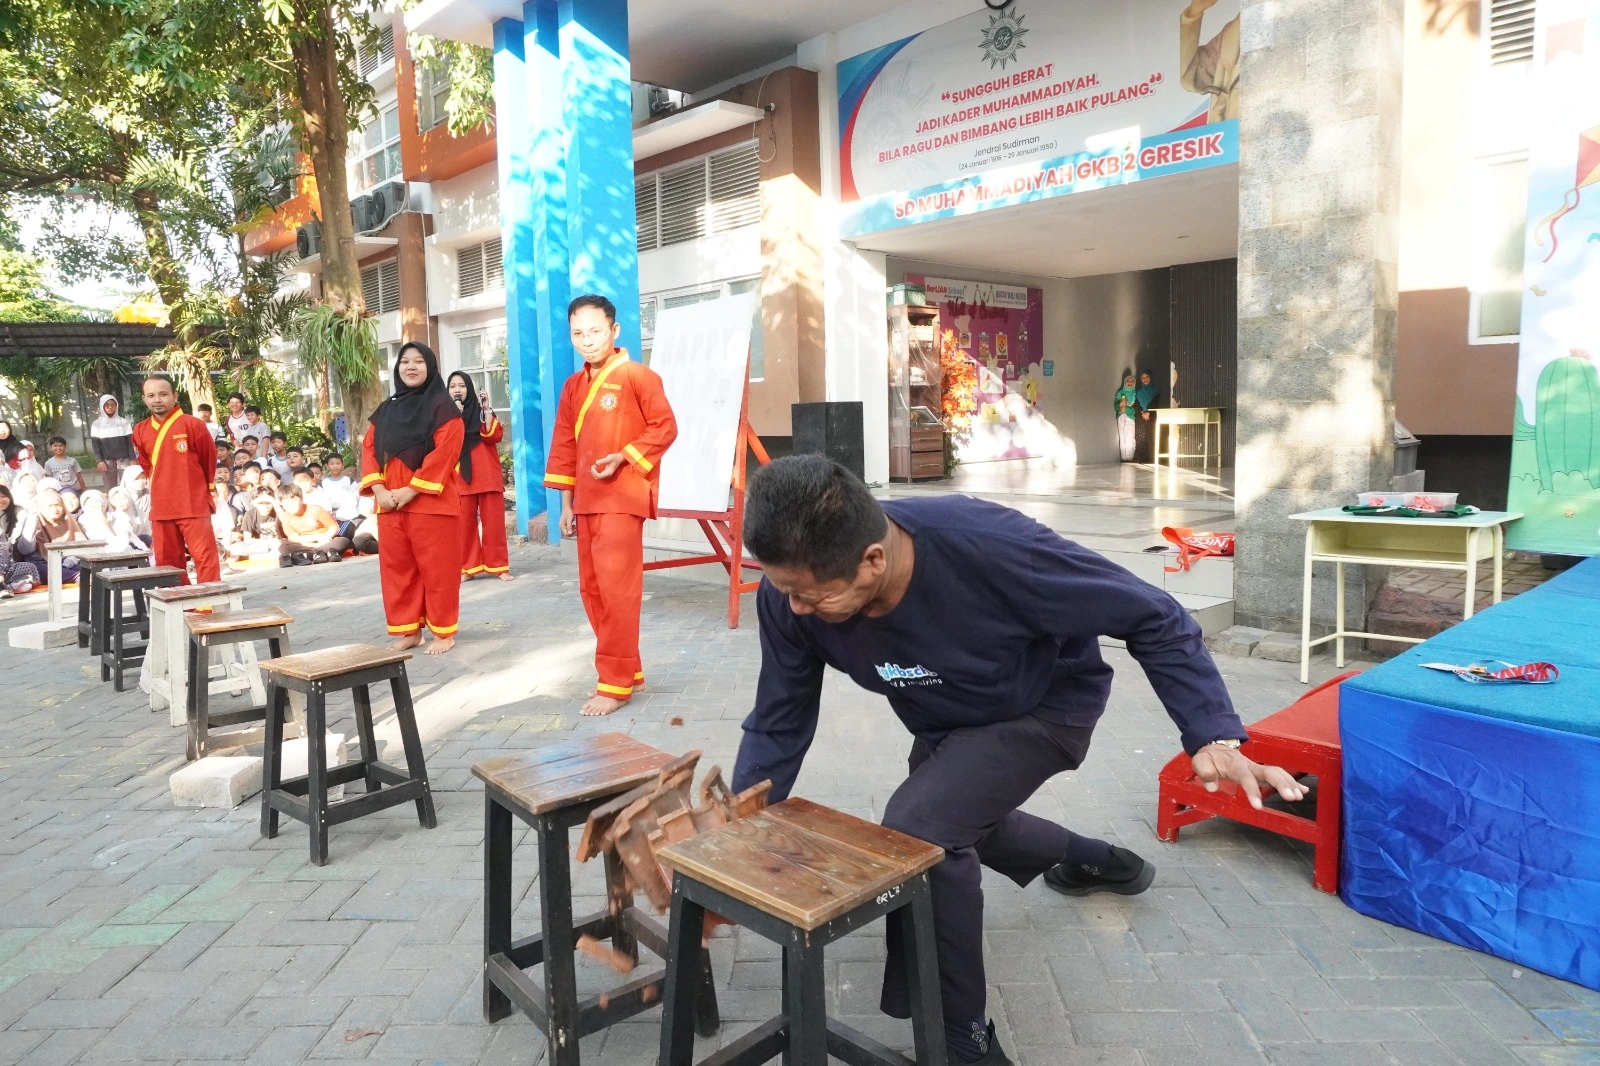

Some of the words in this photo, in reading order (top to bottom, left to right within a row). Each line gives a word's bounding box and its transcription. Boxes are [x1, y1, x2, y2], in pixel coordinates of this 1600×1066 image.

[1012, 64, 1052, 86] BERAT
[916, 117, 940, 133] JADI
[942, 106, 980, 126] KADER
[983, 74, 1099, 115] MUHAMMADIYAH.
[879, 148, 900, 162] BILA
[903, 139, 932, 156] RAGU
[934, 132, 958, 148] DAN
[961, 118, 1017, 141] BIMBANG
[1019, 108, 1053, 126] LEBIH
[1056, 98, 1088, 117] BAIK
[974, 144, 1001, 157] Jendral
[1003, 135, 1040, 150] Sudirman
[1016, 146, 1039, 157] Januari
[895, 200, 915, 218] SD
[918, 165, 1073, 213] MUHAMMADIYAH
[1076, 156, 1119, 180] GKB
[1124, 153, 1135, 171] 2
[1140, 134, 1221, 167] GRESIK
